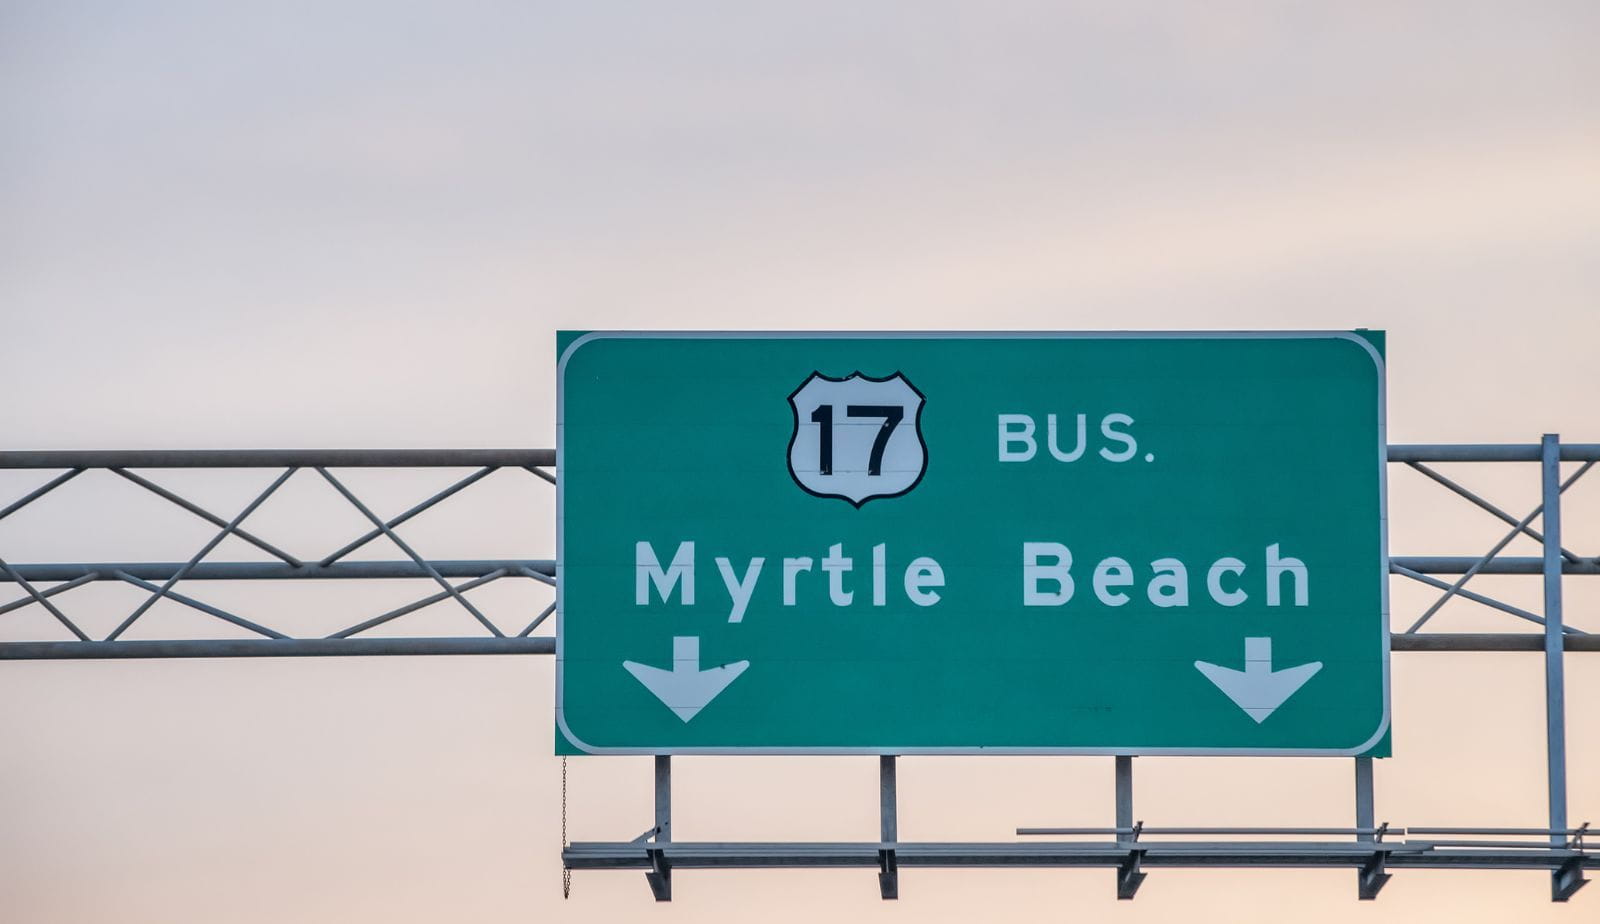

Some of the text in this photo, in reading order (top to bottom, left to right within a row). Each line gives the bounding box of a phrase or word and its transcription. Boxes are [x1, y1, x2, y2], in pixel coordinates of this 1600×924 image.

[811, 404, 1154, 476] 17 BUS.
[636, 541, 1309, 623] Myrtle Beach
